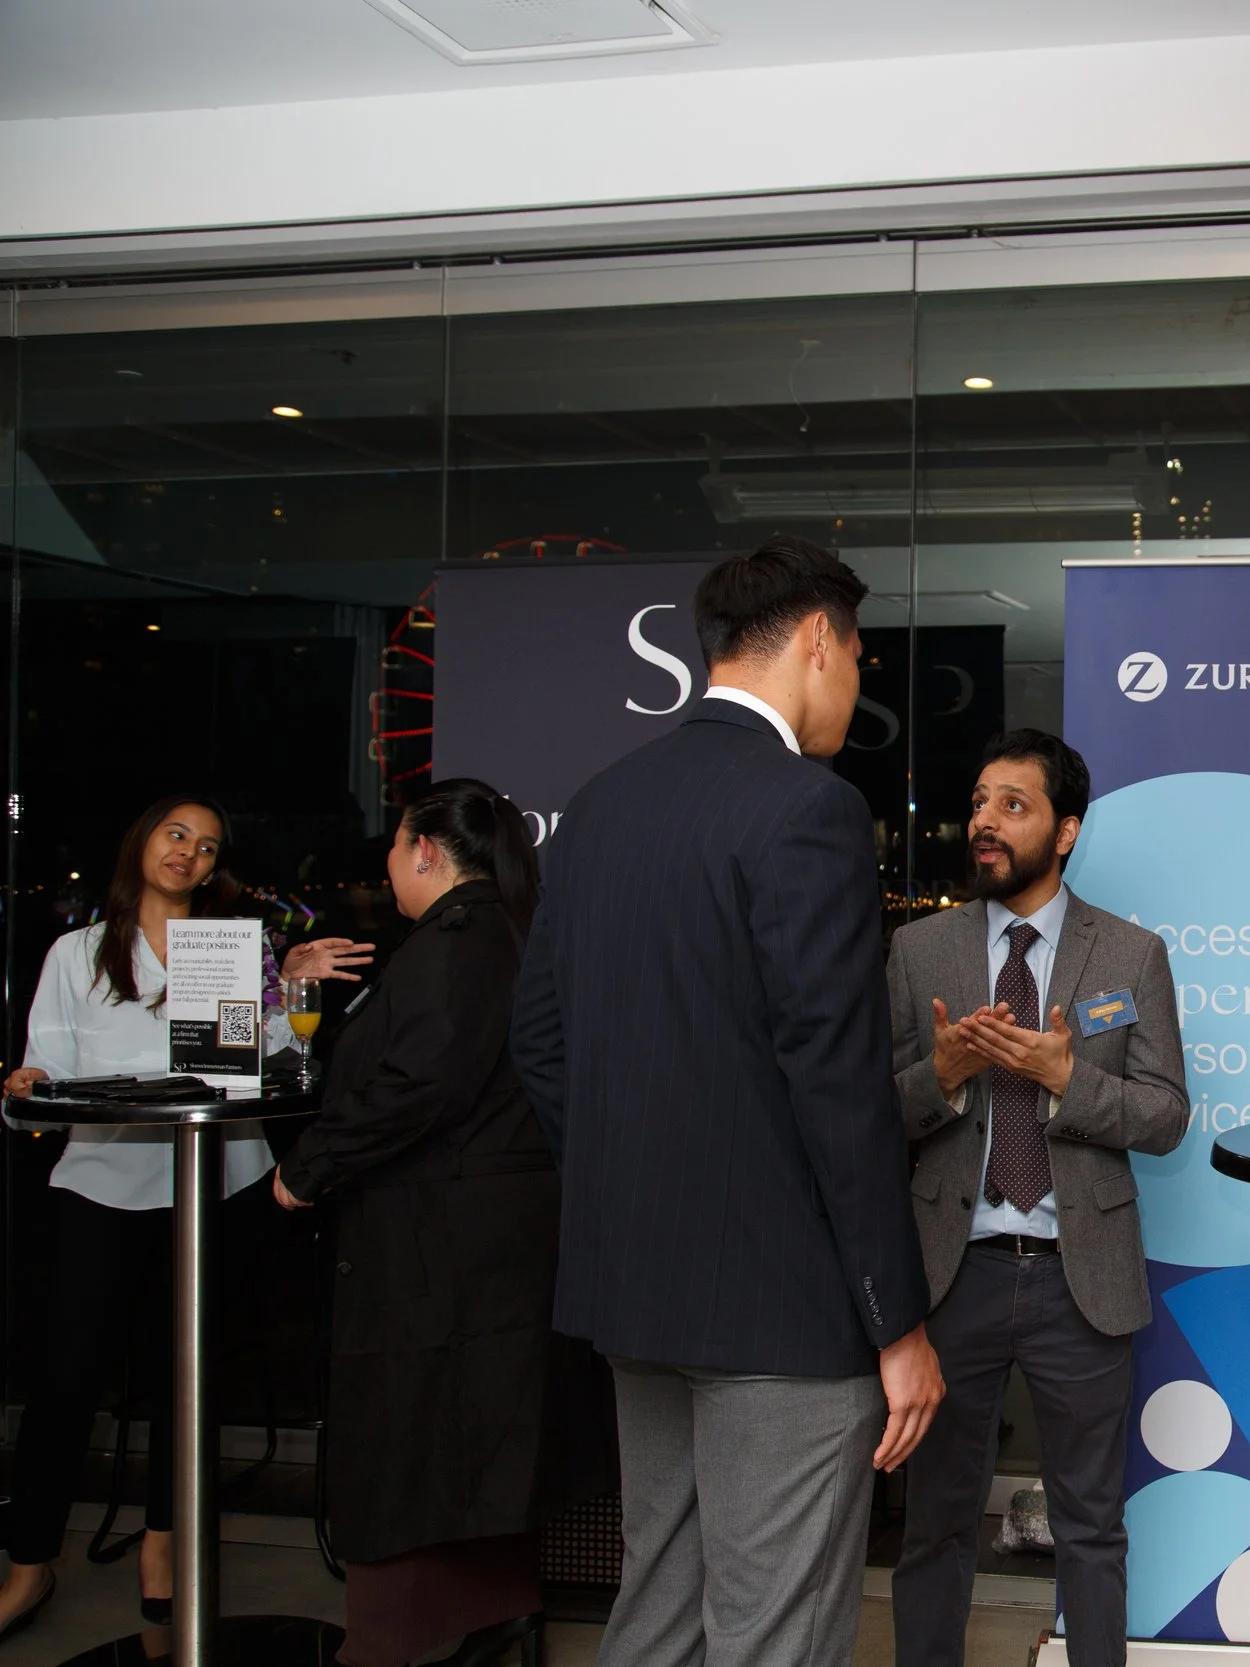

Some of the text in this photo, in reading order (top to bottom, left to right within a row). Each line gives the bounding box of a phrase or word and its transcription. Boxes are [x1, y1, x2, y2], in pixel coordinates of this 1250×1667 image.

[173, 928, 193, 938] Learn
[216, 929, 238, 939] about
[239, 931, 252, 939] our
[172, 939, 240, 951] graduate positions
